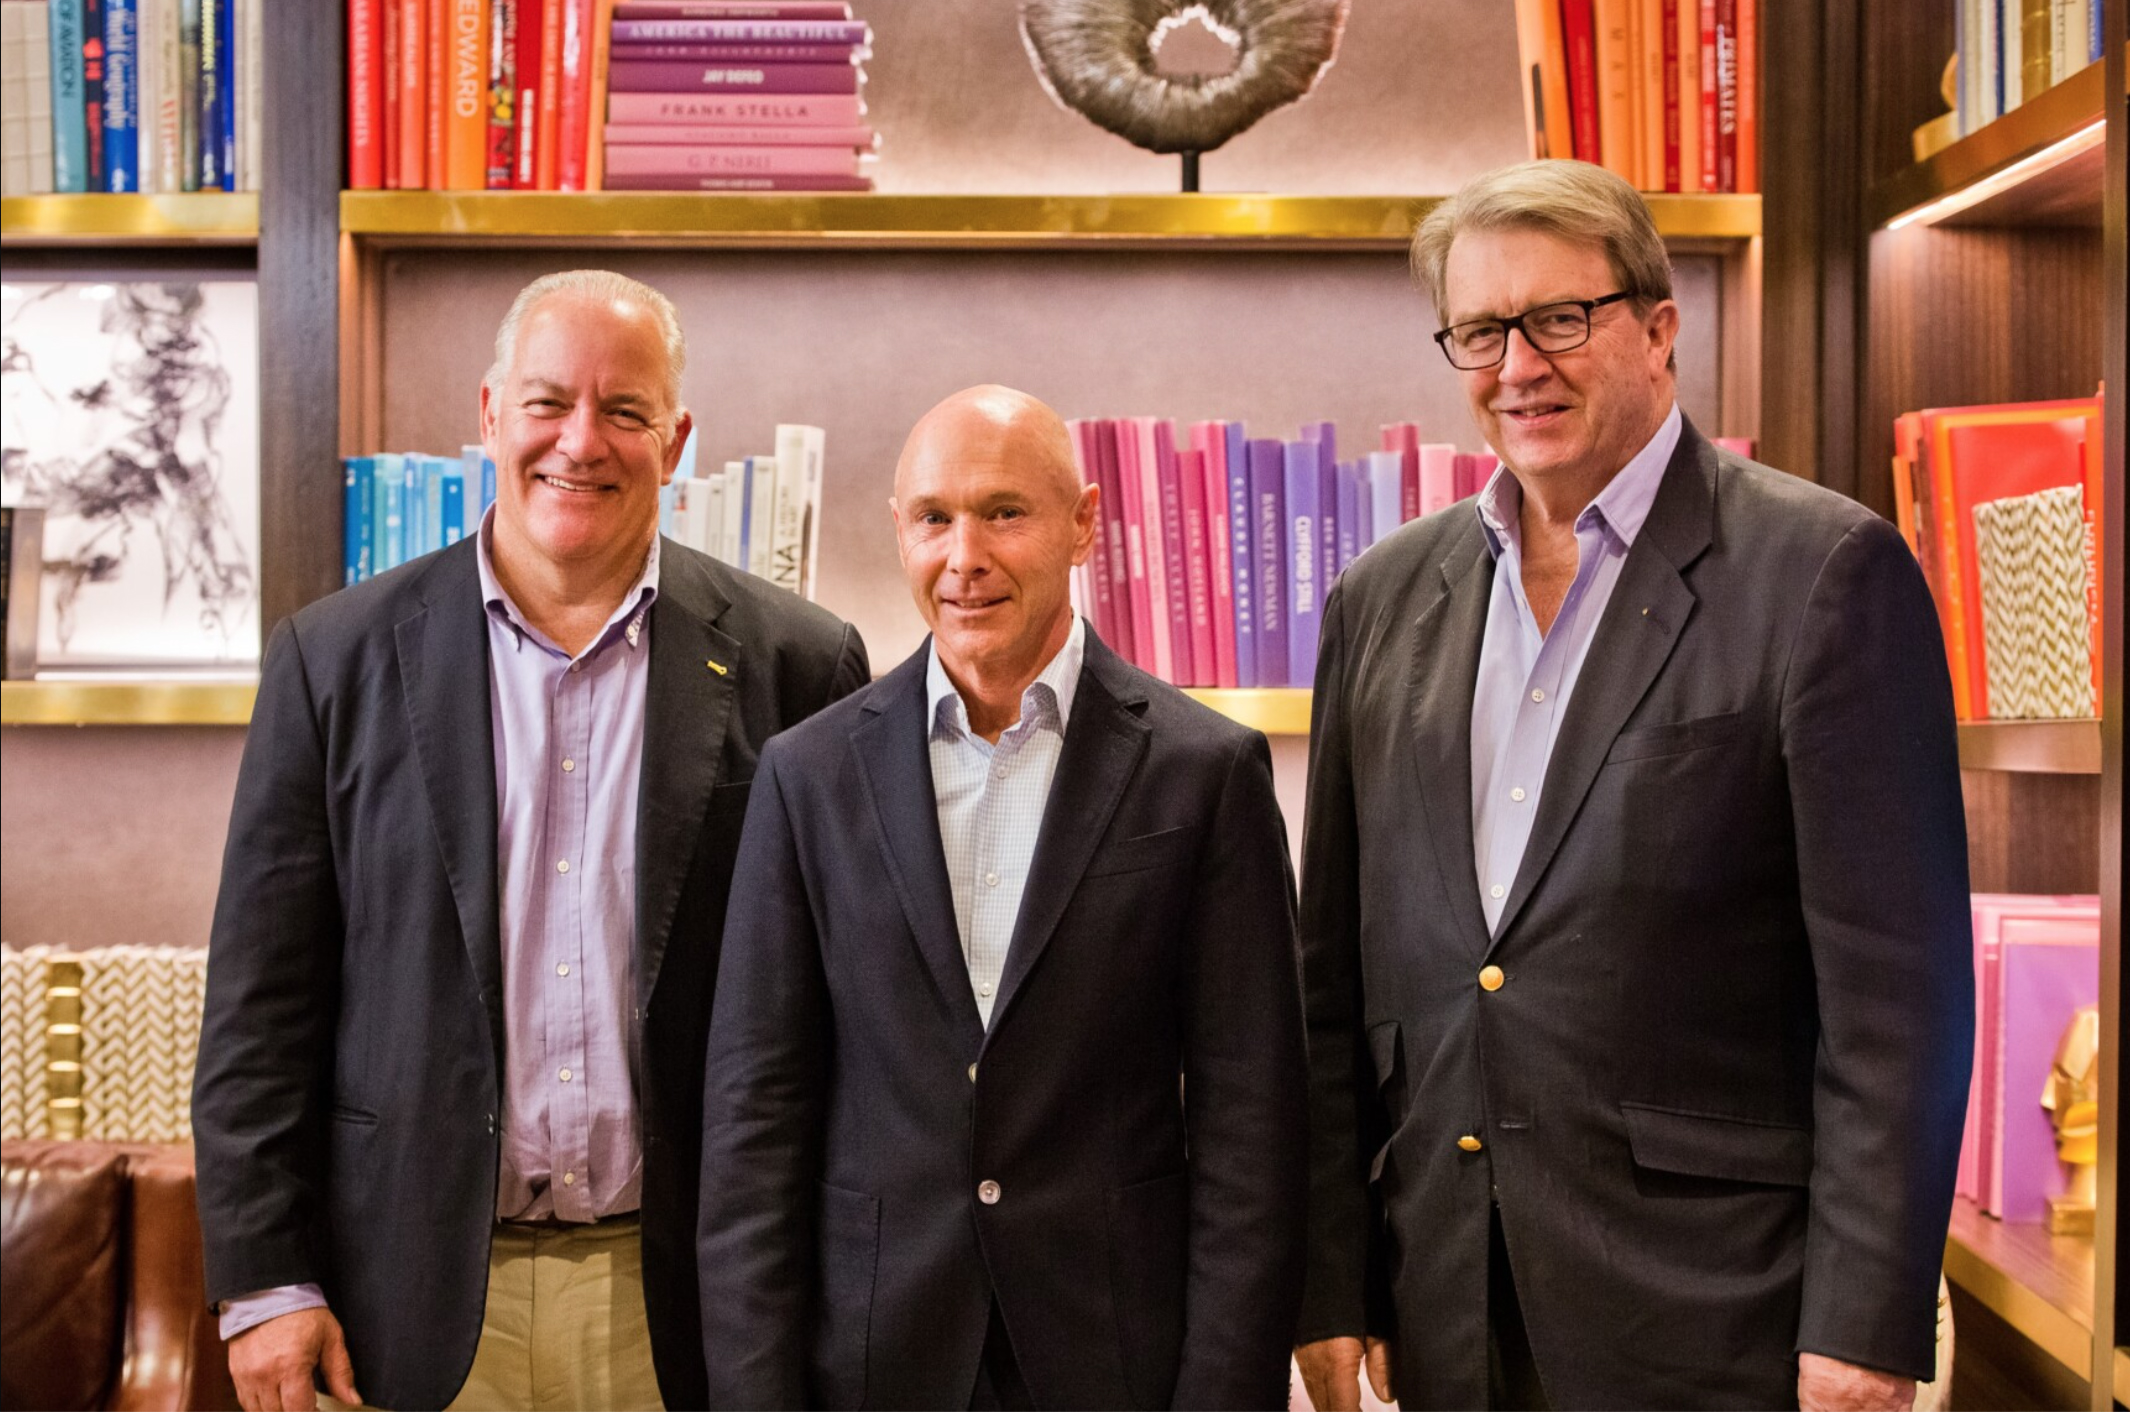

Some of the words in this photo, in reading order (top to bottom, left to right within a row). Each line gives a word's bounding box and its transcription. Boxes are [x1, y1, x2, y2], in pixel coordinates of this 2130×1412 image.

[58, 25, 76, 98] AVIATION
[456, 0, 480, 118] EDWARD
[629, 25, 706, 39] AMERICA
[713, 25, 745, 39] THE
[752, 25, 849, 39] BEAUTIFUL
[660, 104, 727, 117] FRANK
[736, 104, 810, 117] STELLA
[1261, 493, 1277, 559] BARNETT
[1263, 564, 1278, 631] NEWMAN
[1296, 582, 1313, 615] STILL
